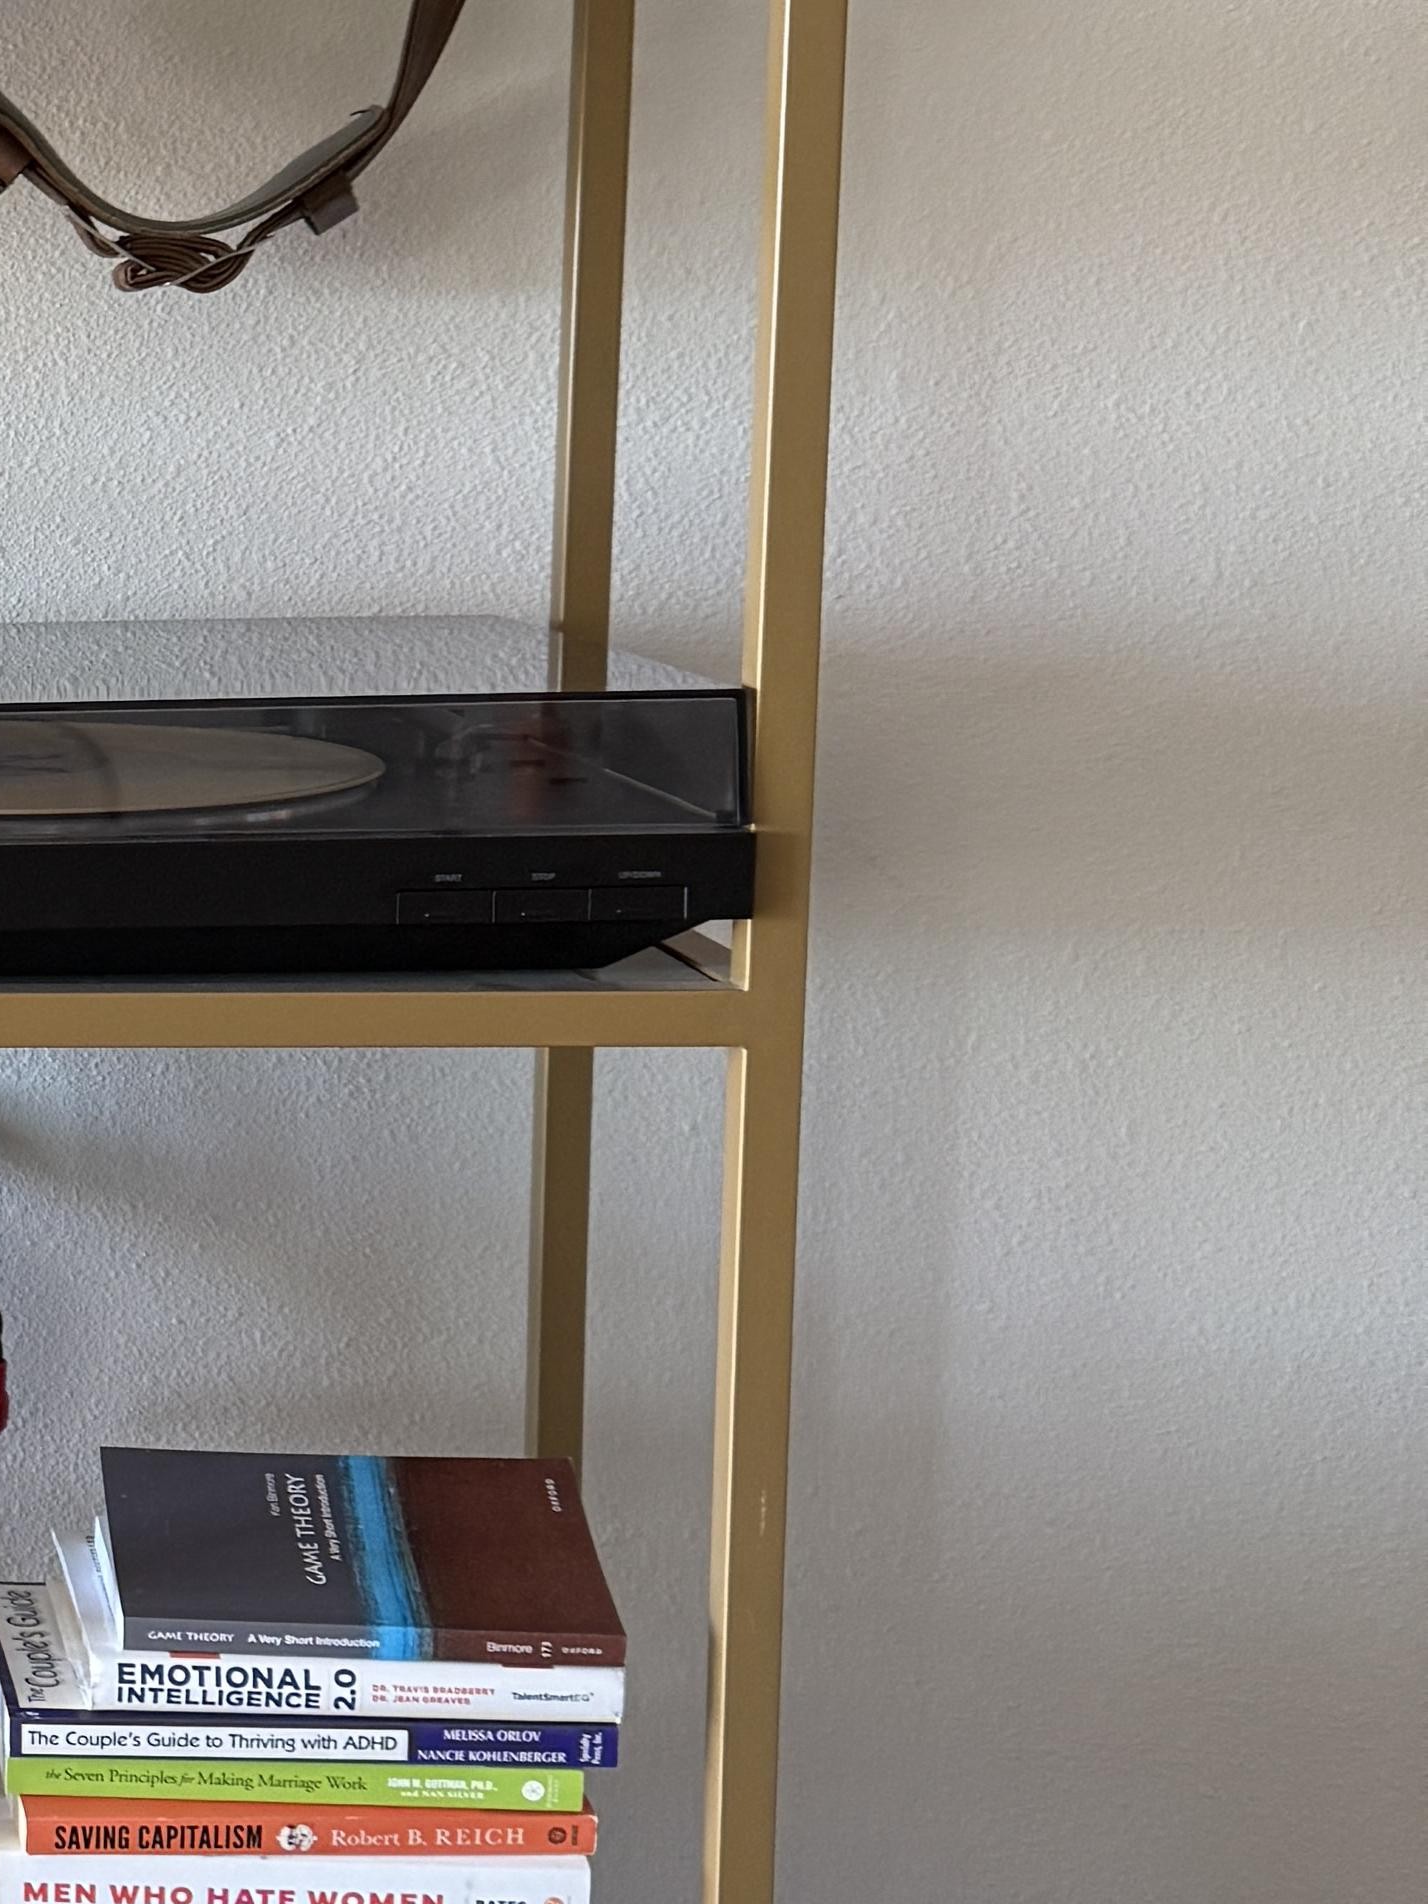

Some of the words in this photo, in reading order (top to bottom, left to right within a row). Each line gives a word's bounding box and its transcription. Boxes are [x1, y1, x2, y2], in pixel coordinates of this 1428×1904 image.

[117, 1663, 321, 1690] EMOTIONAL
[334, 1668, 356, 1710] 2.0
[117, 1687, 321, 1709] INTELLIGENCE
[28, 1730, 60, 1748] The
[66, 1730, 141, 1754] Couple's
[147, 1732, 200, 1750] Guide
[205, 1734, 223, 1749] to
[229, 1734, 294, 1757] Thriving
[300, 1735, 337, 1751] with
[344, 1735, 398, 1751] ADHD
[54, 1824, 132, 1851] SAVING
[137, 1824, 263, 1850] CAPITALISM
[331, 1829, 403, 1847] Robert
[408, 1828, 428, 1846] B.
[435, 1827, 525, 1846] REICH
[23, 1883, 97, 1904] MEN
